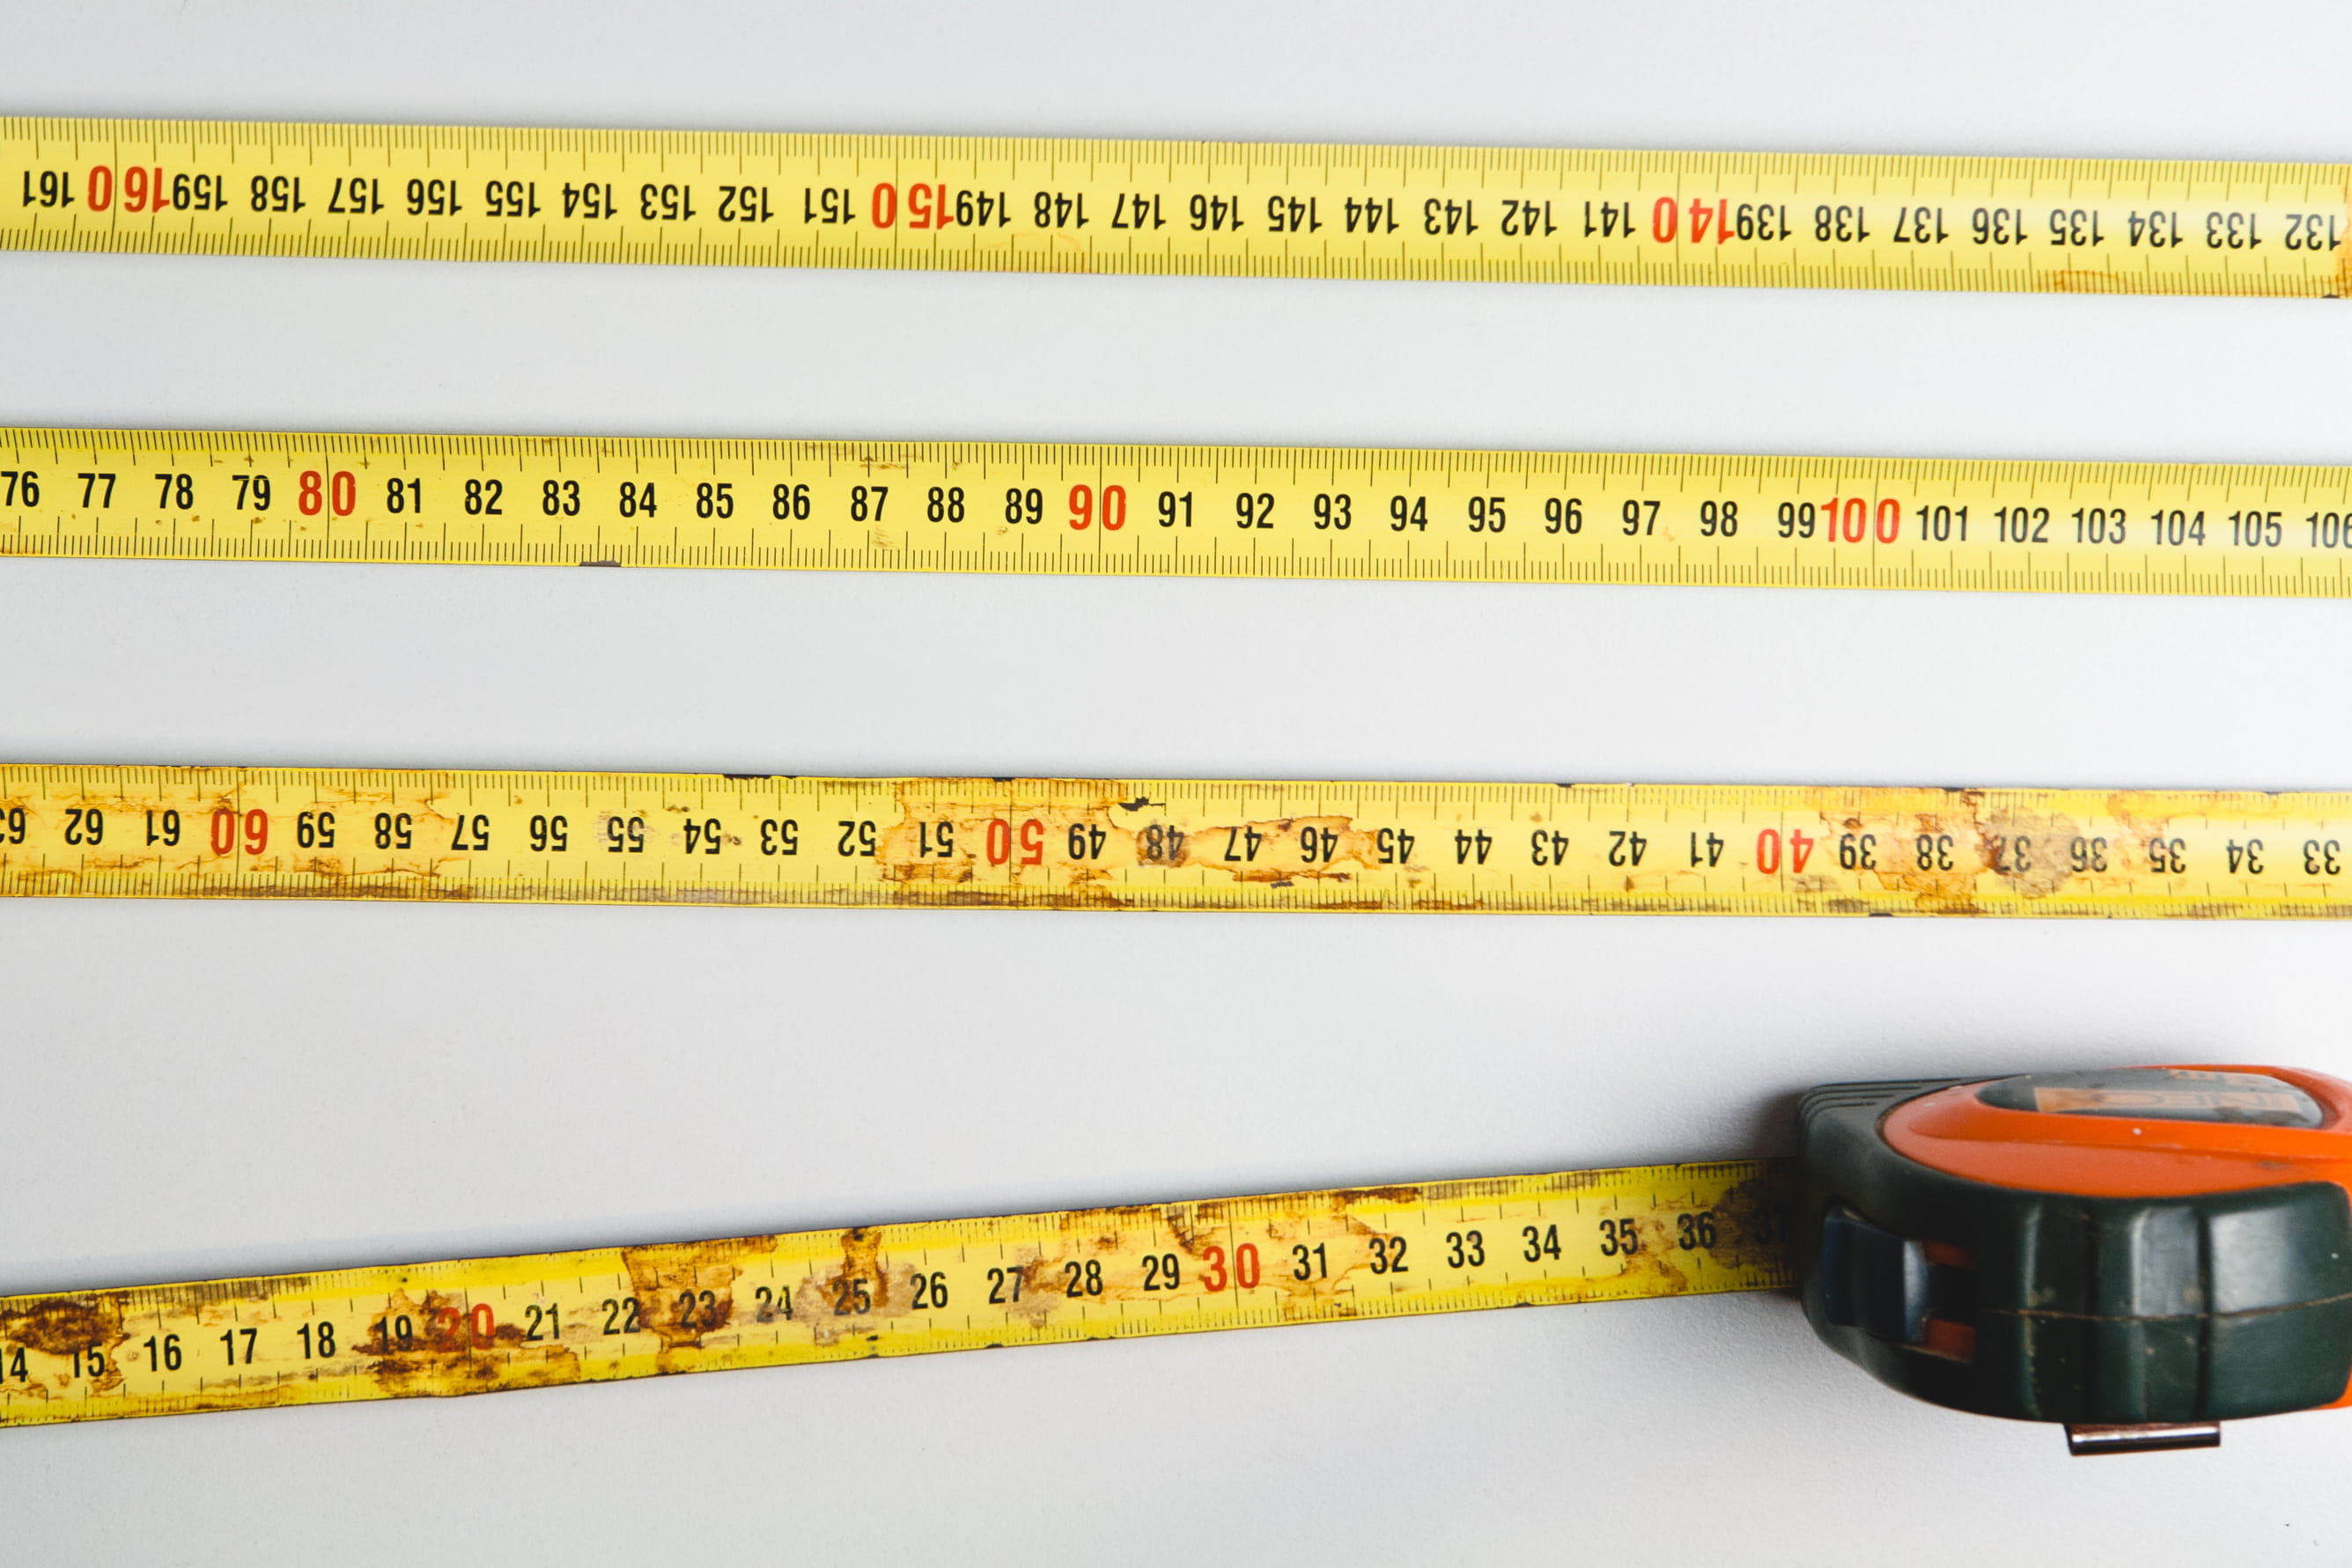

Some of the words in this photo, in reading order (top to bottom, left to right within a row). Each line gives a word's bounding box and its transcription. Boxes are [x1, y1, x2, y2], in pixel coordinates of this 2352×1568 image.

[22, 170, 75, 209] 161
[86, 165, 171, 214] 160
[173, 173, 228, 211] 159
[250, 175, 306, 213] 158
[328, 177, 385, 215] 157
[407, 178, 462, 217] 156
[485, 180, 542, 218] 155
[562, 182, 618, 220] 154
[640, 183, 697, 221] 153
[718, 186, 774, 223] 152
[804, 188, 856, 225] 151
[871, 181, 955, 231] 150
[955, 189, 1012, 228] 149
[1034, 191, 1089, 229] 148
[1111, 193, 1167, 230] 147
[1190, 194, 1244, 232] 146
[1267, 195, 1323, 233] 145
[1344, 196, 1399, 234] 144
[1424, 198, 1478, 236] 143
[1500, 200, 1558, 237] 142
[1584, 201, 1636, 239] 141
[1651, 196, 1736, 246] 140
[1736, 203, 1792, 241] 139
[1815, 205, 1870, 243] 138
[1893, 207, 1949, 244] 137
[1972, 208, 2028, 246] 136
[2049, 209, 2105, 247] 135
[2128, 210, 2183, 248] 134
[2207, 212, 2262, 249] 133
[2285, 214, 2341, 251] 132
[1, 470, 40, 507] 76
[77, 473, 116, 509] 77
[155, 473, 194, 510] 78
[234, 475, 270, 512] 79
[298, 469, 357, 517] 80
[387, 477, 421, 514] 81
[464, 479, 503, 515] 82
[542, 479, 580, 516] 83
[619, 482, 657, 518] 84
[696, 482, 734, 519] 85
[772, 483, 810, 520] 86
[851, 485, 888, 522] 87
[927, 486, 965, 523] 88
[1005, 488, 1043, 525] 89
[1068, 483, 1127, 532] 90
[1158, 491, 1192, 527] 91
[1236, 492, 1274, 529] 92
[1314, 493, 1352, 530] 93
[1390, 495, 1428, 532] 94
[1468, 496, 1506, 533] 95
[1545, 497, 1582, 534] 96
[1622, 499, 1661, 536] 97
[1699, 500, 1738, 537] 98
[1778, 502, 1816, 539] 99
[1820, 497, 1901, 545] 100
[1916, 504, 1967, 541] 101
[1994, 506, 2050, 543] 102
[2071, 507, 2126, 544] 103
[2150, 510, 2205, 546] 104
[2228, 511, 2282, 547] 105
[0, 807, 26, 844] 6
[65, 808, 103, 846] 62
[147, 809, 181, 847] 61
[210, 808, 269, 856] 60
[298, 811, 335, 849] 59
[374, 813, 412, 850] 58
[452, 814, 490, 851] 57
[530, 814, 568, 852] 56
[608, 816, 644, 853] 55
[683, 818, 721, 855] 54
[761, 819, 798, 856] 53
[838, 821, 876, 857] 52
[920, 821, 954, 858] 51
[986, 818, 1044, 866] 50
[1068, 823, 1106, 860] 49
[1147, 826, 1183, 860] 48
[1224, 826, 1262, 862] 47
[1301, 826, 1338, 863] 46
[1377, 828, 1414, 864] 45
[1455, 829, 1492, 865] 44
[1531, 830, 1568, 866] 43
[1610, 832, 1646, 866] 42
[1692, 833, 1723, 867] 41
[1756, 828, 1815, 875] 40
[1840, 833, 1876, 870] 39
[1916, 835, 1953, 871] 38
[1994, 836, 2031, 872] 37
[2072, 837, 2108, 872] 36
[2149, 838, 2186, 873] 35
[2227, 840, 2264, 874] 34
[2304, 841, 2341, 875] 33
[67, 1342, 106, 1379] 15
[144, 1334, 181, 1372] 16
[220, 1328, 257, 1366] 17
[298, 1321, 335, 1359] 18
[374, 1315, 413, 1354] 19
[435, 1303, 497, 1351] 20
[527, 1305, 559, 1340] 21
[602, 1298, 640, 1335] 22
[680, 1292, 717, 1329] 23
[756, 1286, 793, 1323] 24
[835, 1280, 871, 1317] 25
[912, 1274, 948, 1310] 26
[988, 1268, 1025, 1305] 27
[1065, 1260, 1102, 1298] 28
[1142, 1254, 1179, 1291] 29
[1201, 1242, 1261, 1292] 30
[1293, 1243, 1327, 1281] 31
[1369, 1237, 1408, 1274] 32
[1447, 1230, 1485, 1269] 33
[1523, 1225, 1561, 1262] 34
[1600, 1218, 1638, 1256] 35
[1677, 1211, 1716, 1250] 36
